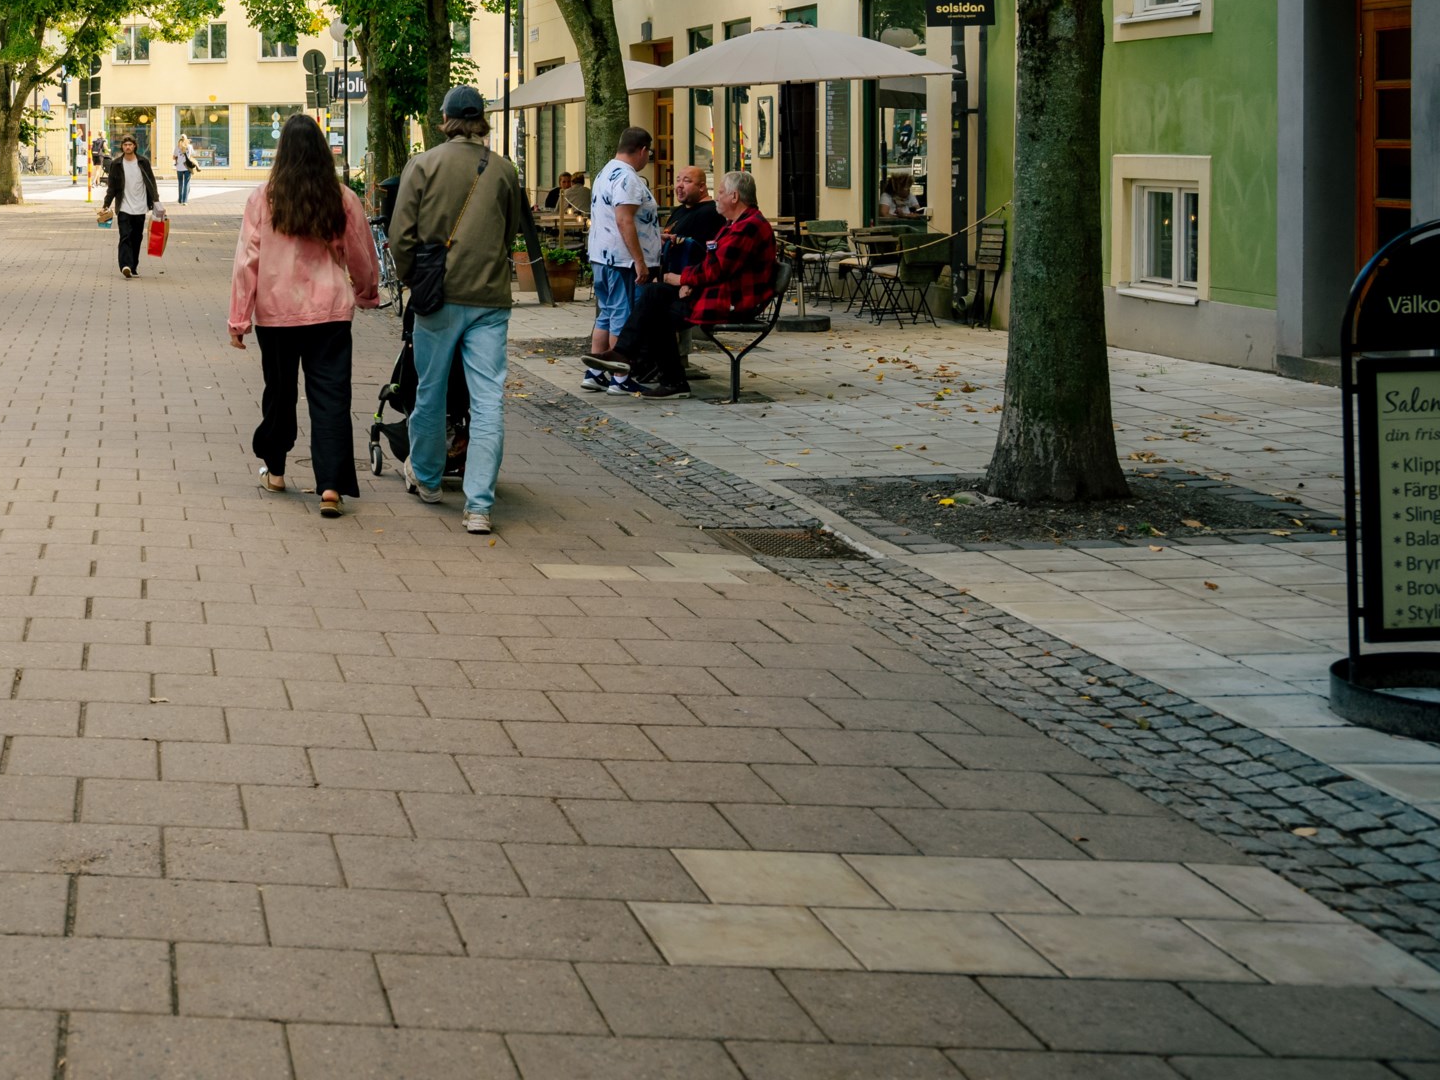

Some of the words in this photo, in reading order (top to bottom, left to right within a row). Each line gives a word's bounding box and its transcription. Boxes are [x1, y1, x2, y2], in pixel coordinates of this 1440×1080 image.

[935, 2, 985, 13] solsidan
[1387, 294, 1440, 314] Välko
[1385, 428, 1410, 442] din
[1404, 482, 1440, 501] Färg
[1406, 530, 1440, 547] Bala
